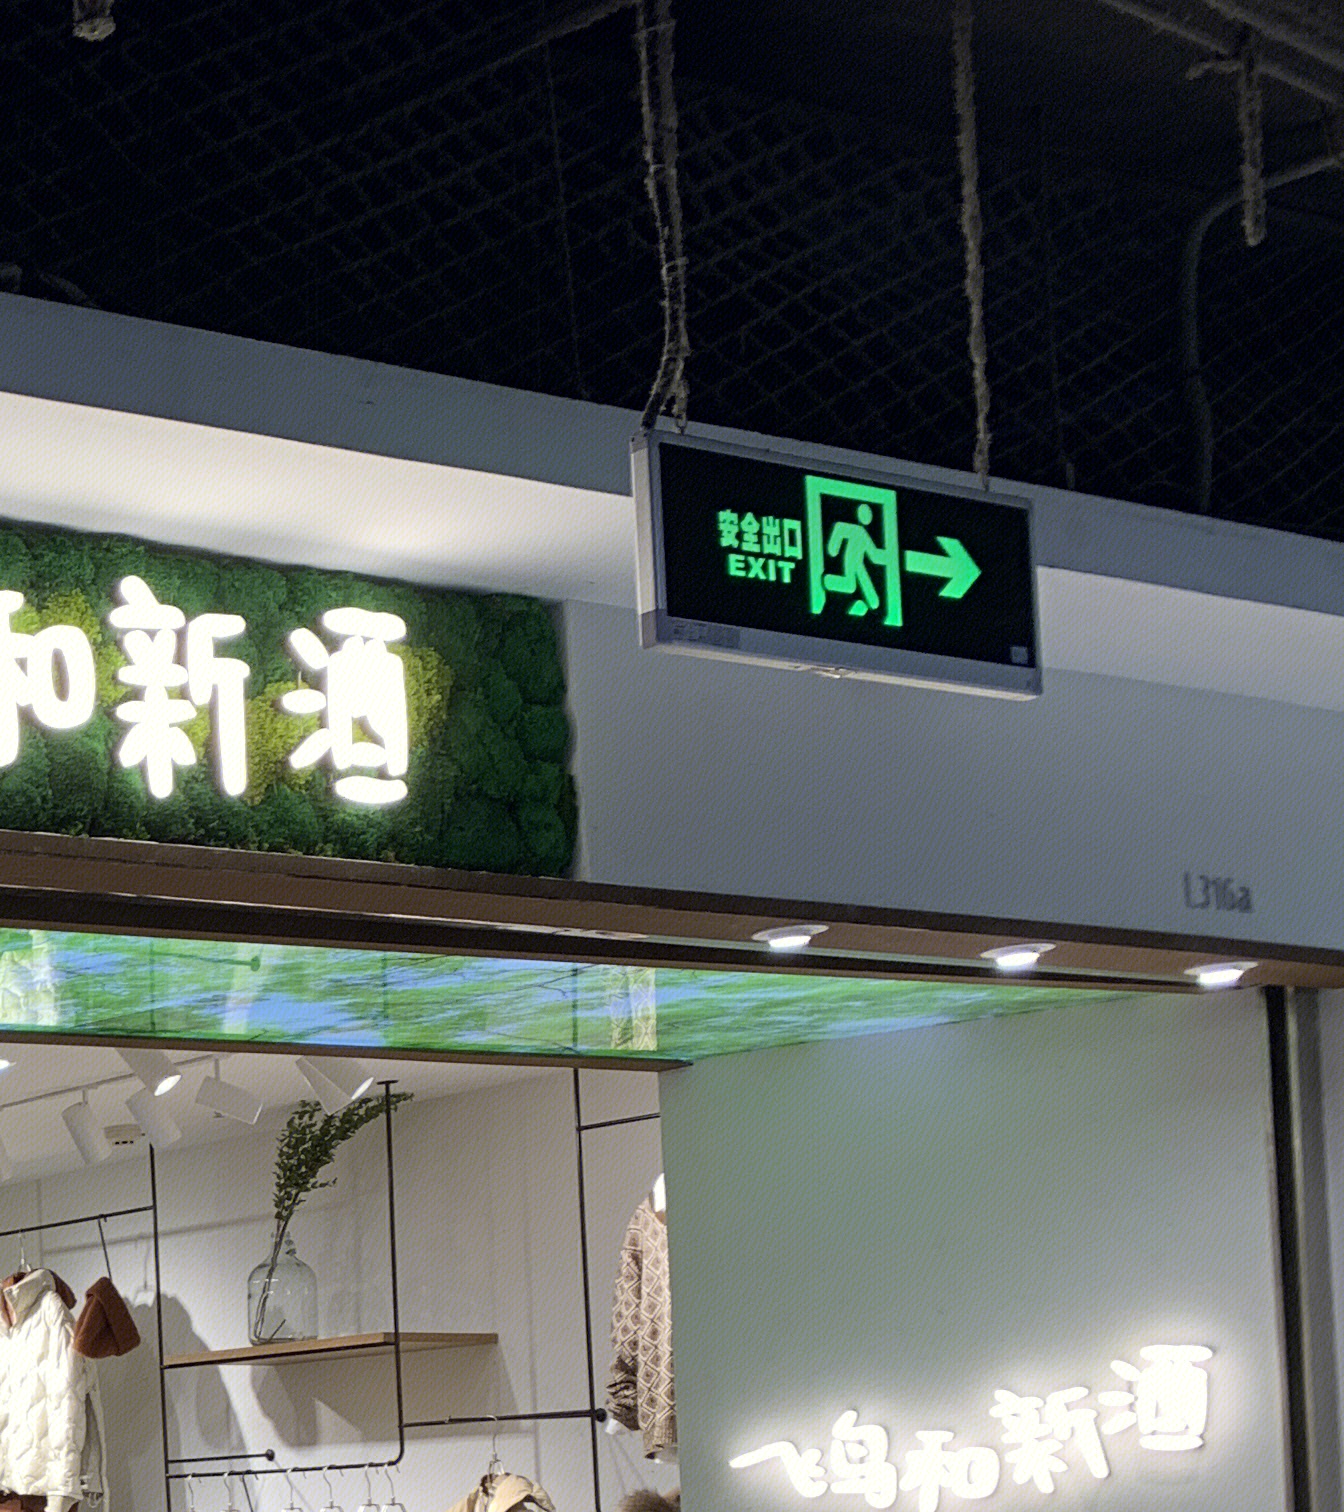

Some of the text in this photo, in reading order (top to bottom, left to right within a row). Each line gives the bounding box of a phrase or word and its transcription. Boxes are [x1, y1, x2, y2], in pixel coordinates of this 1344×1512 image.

[717, 508, 803, 560] 安全出口
[728, 553, 796, 584] EXIT
